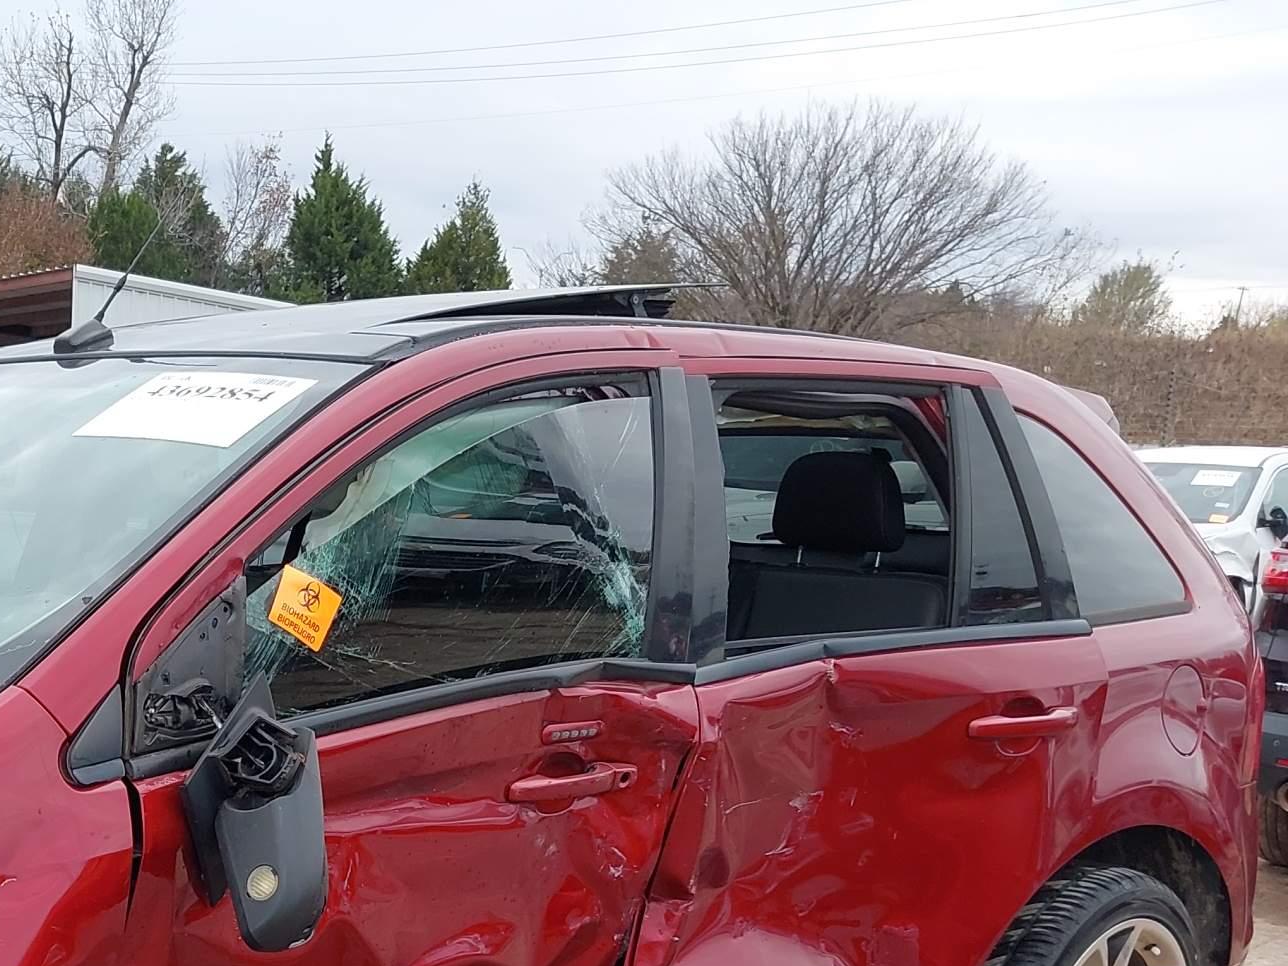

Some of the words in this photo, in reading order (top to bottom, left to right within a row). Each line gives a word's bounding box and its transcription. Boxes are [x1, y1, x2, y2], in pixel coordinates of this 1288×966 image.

[148, 384, 275, 402] 43692854
[277, 613, 315, 644] BIOPELIGRO
[281, 602, 319, 632] BIOHAZARD
